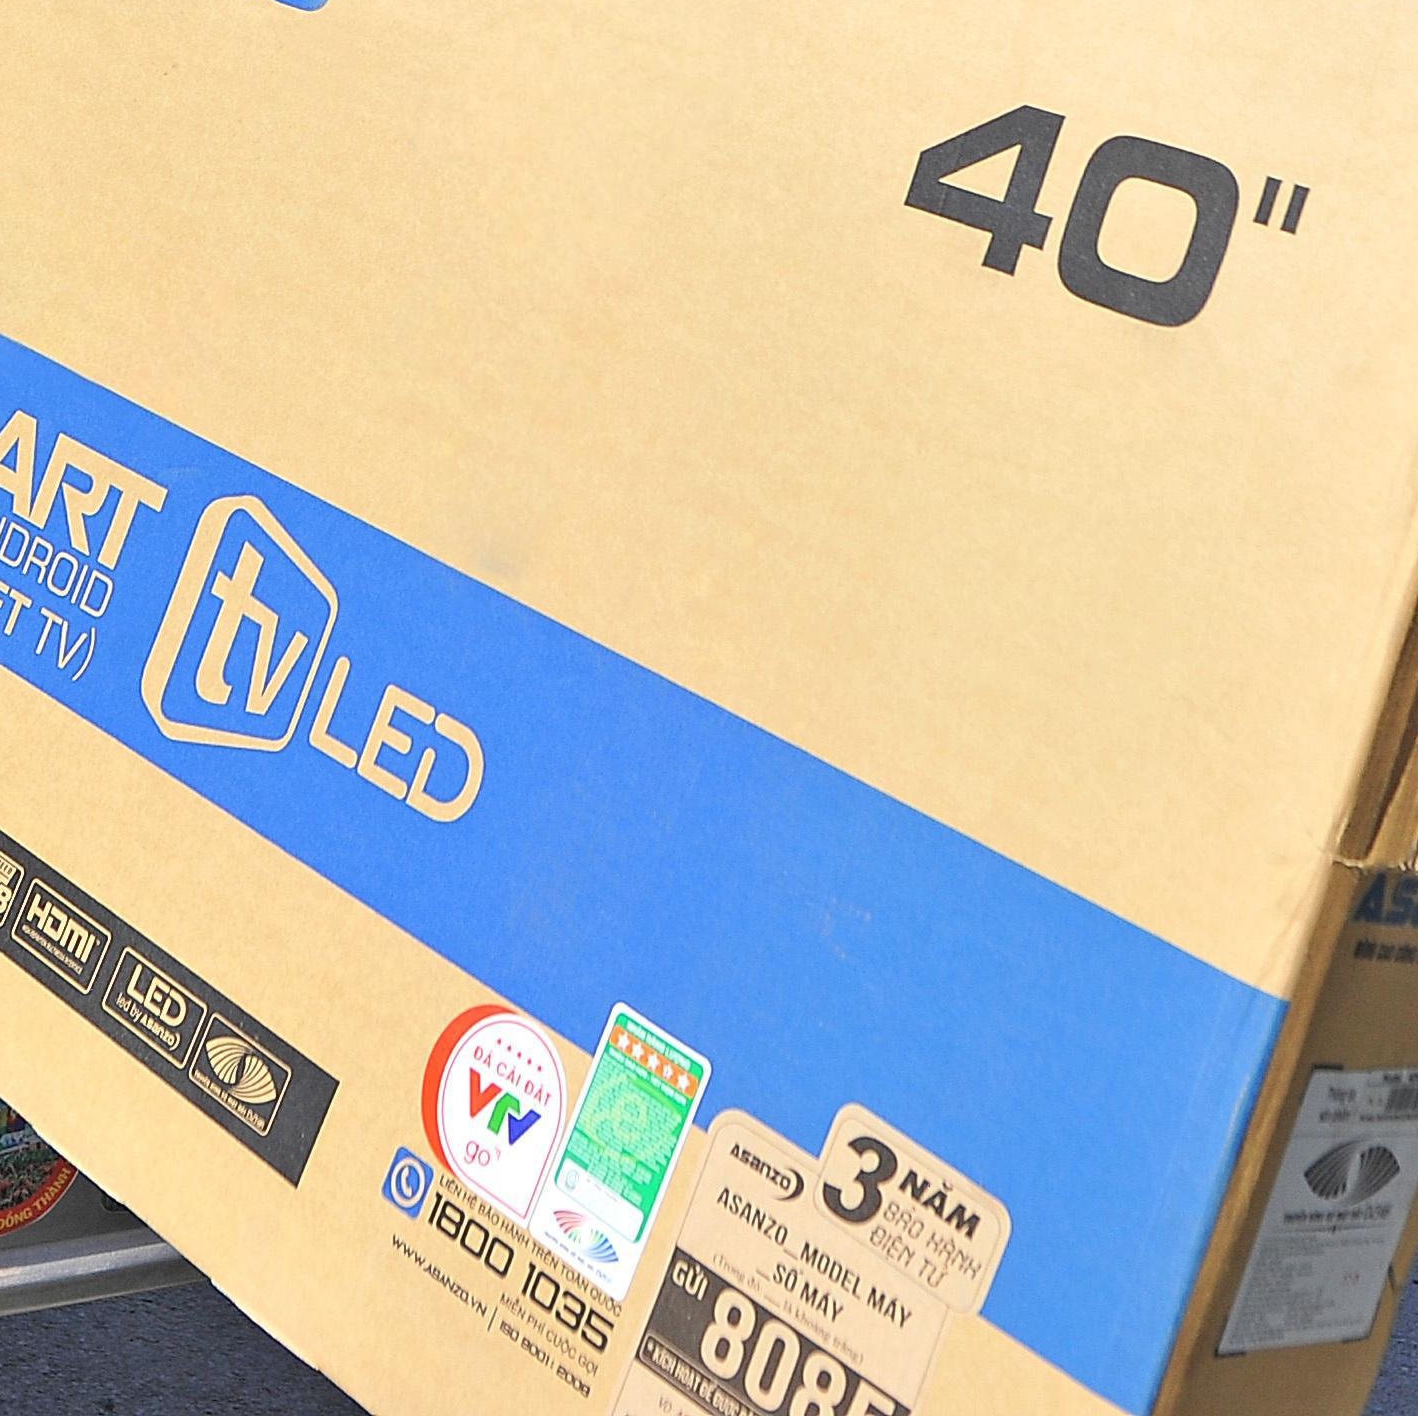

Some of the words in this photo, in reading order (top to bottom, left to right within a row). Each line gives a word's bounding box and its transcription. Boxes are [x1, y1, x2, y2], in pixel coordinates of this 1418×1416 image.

[904, 104, 1310, 327] 40"
[35, 607, 97, 682] TV)
[195, 540, 309, 716] tv
[308, 656, 485, 823] LED
[26, 893, 97, 963] HDMI
[127, 964, 187, 1027] LED
[464, 1139, 491, 1167] go
[729, 1142, 793, 1191] Asanzo
[822, 1136, 899, 1223] 3
[899, 1170, 981, 1240] NĂM
[439, 1173, 462, 1198] LIÊN
[531, 1242, 560, 1270] TRÊN
[869, 1224, 916, 1269] ĐIỆN
[426, 1191, 515, 1281] 1800
[521, 1260, 615, 1354] 1035
[800, 1281, 845, 1324] MÁY
[499, 1319, 520, 1343] ISO
[867, 1287, 913, 1329] MÁY
